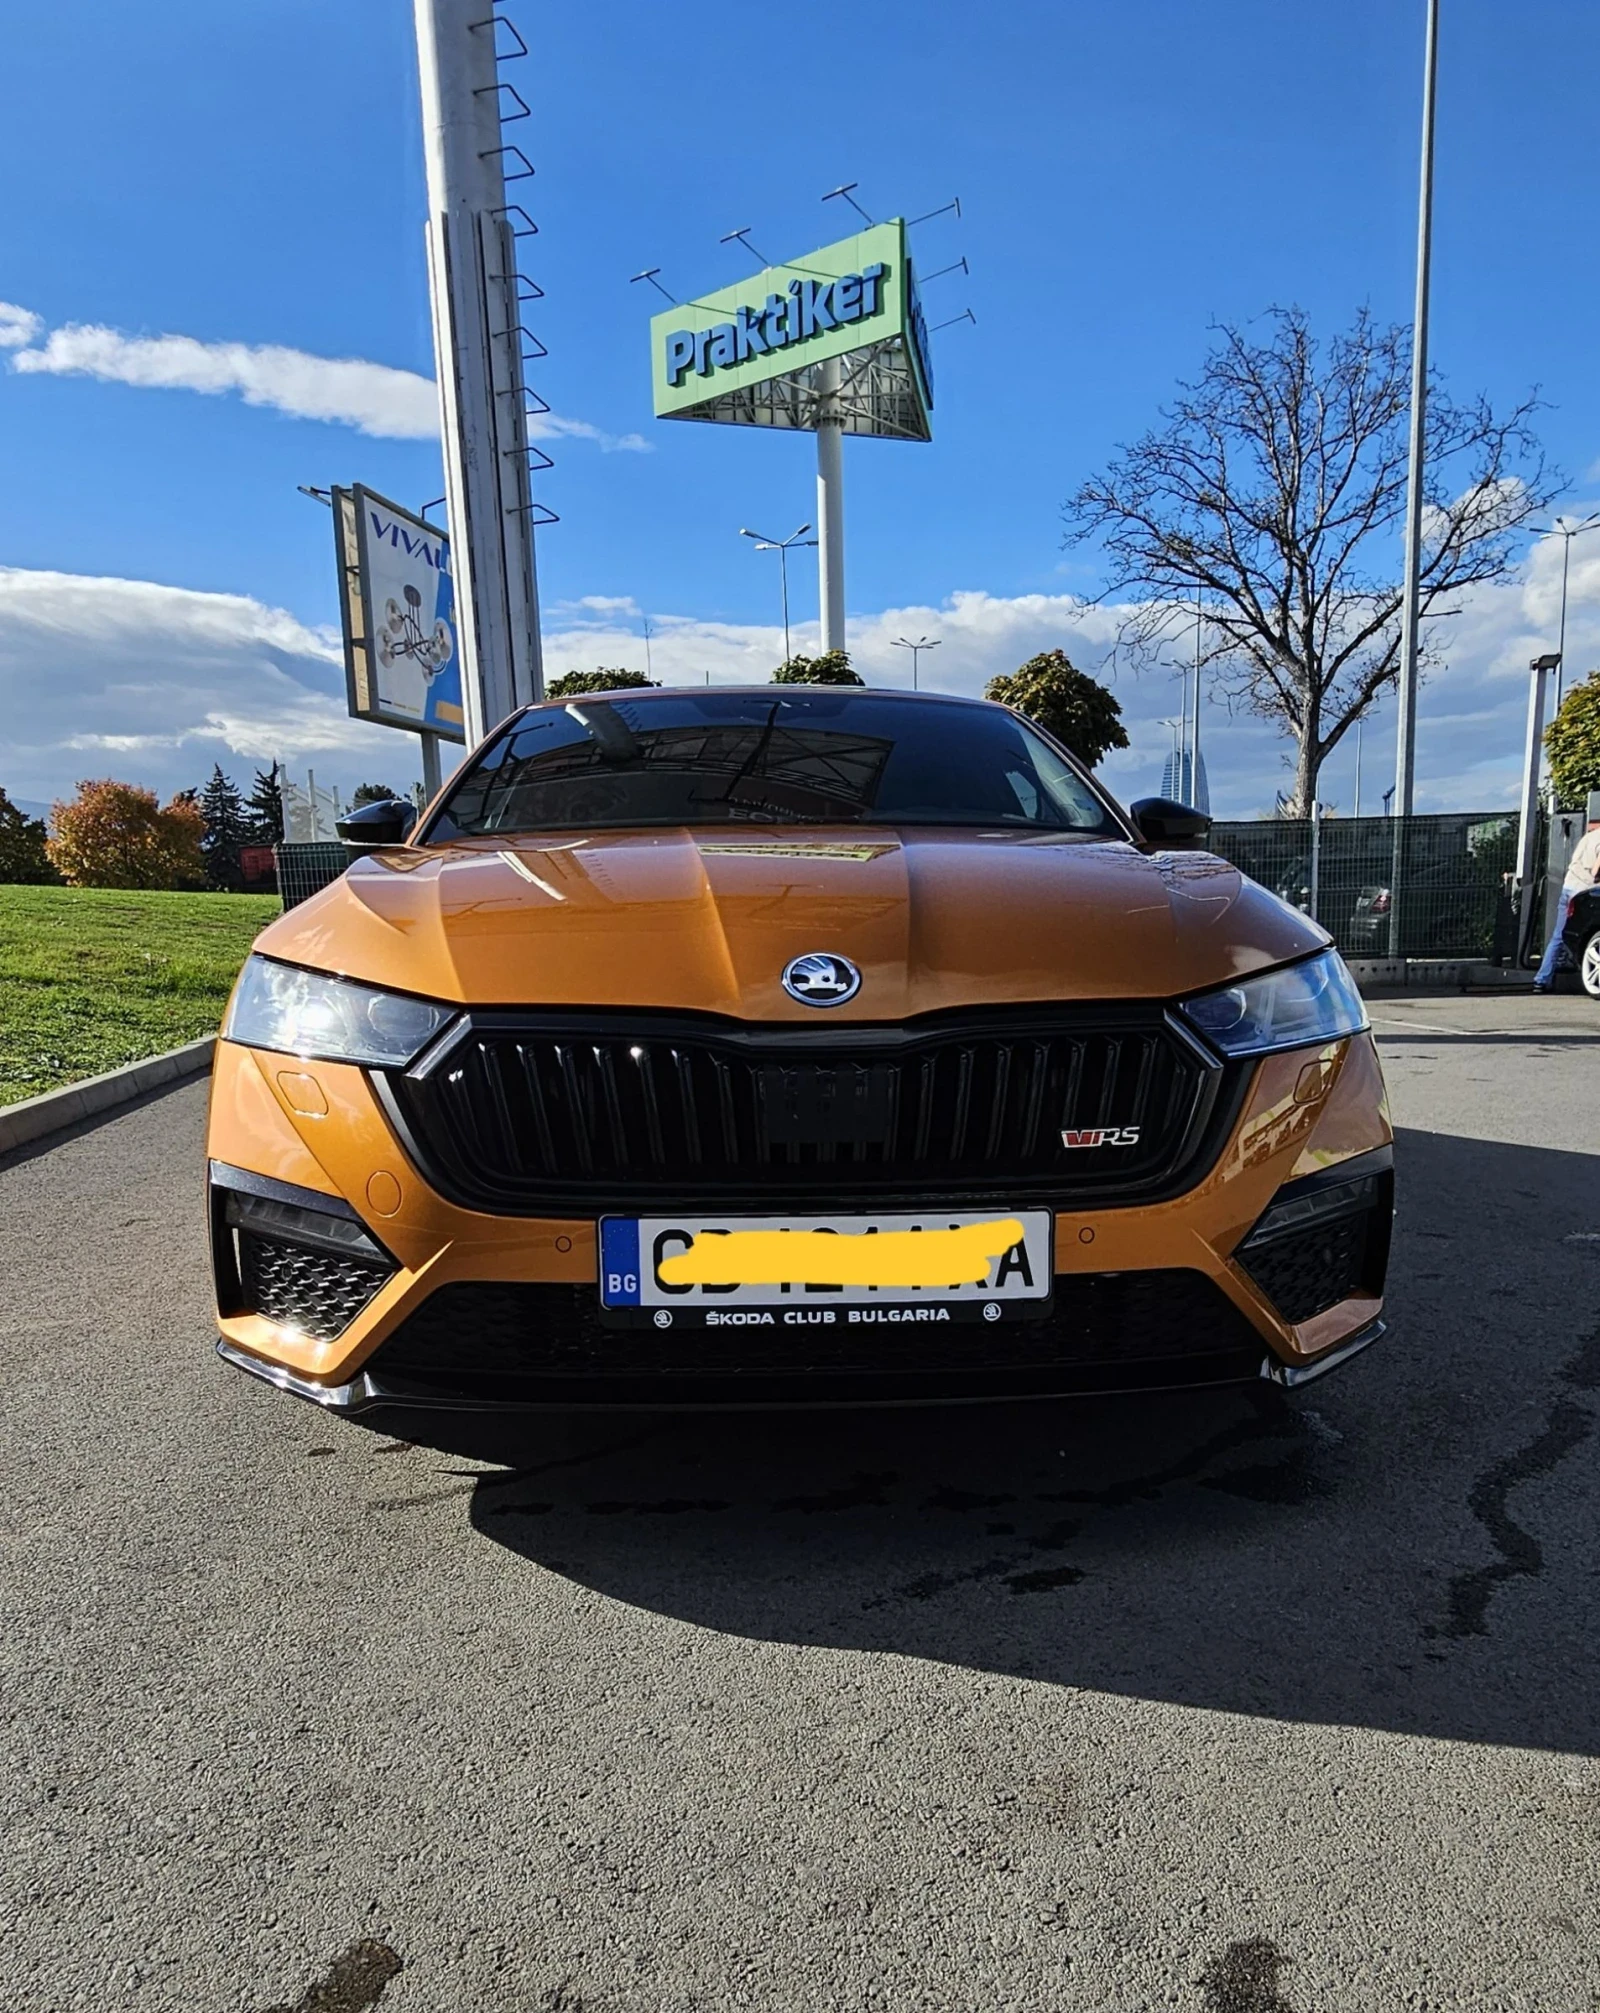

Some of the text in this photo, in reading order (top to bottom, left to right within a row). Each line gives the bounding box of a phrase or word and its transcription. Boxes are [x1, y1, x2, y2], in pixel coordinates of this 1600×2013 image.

[666, 262, 887, 387] Praktiker
[608, 1273, 637, 1293] BG
[706, 1308, 950, 1326] ŠKODA CLUB BULGARIA
